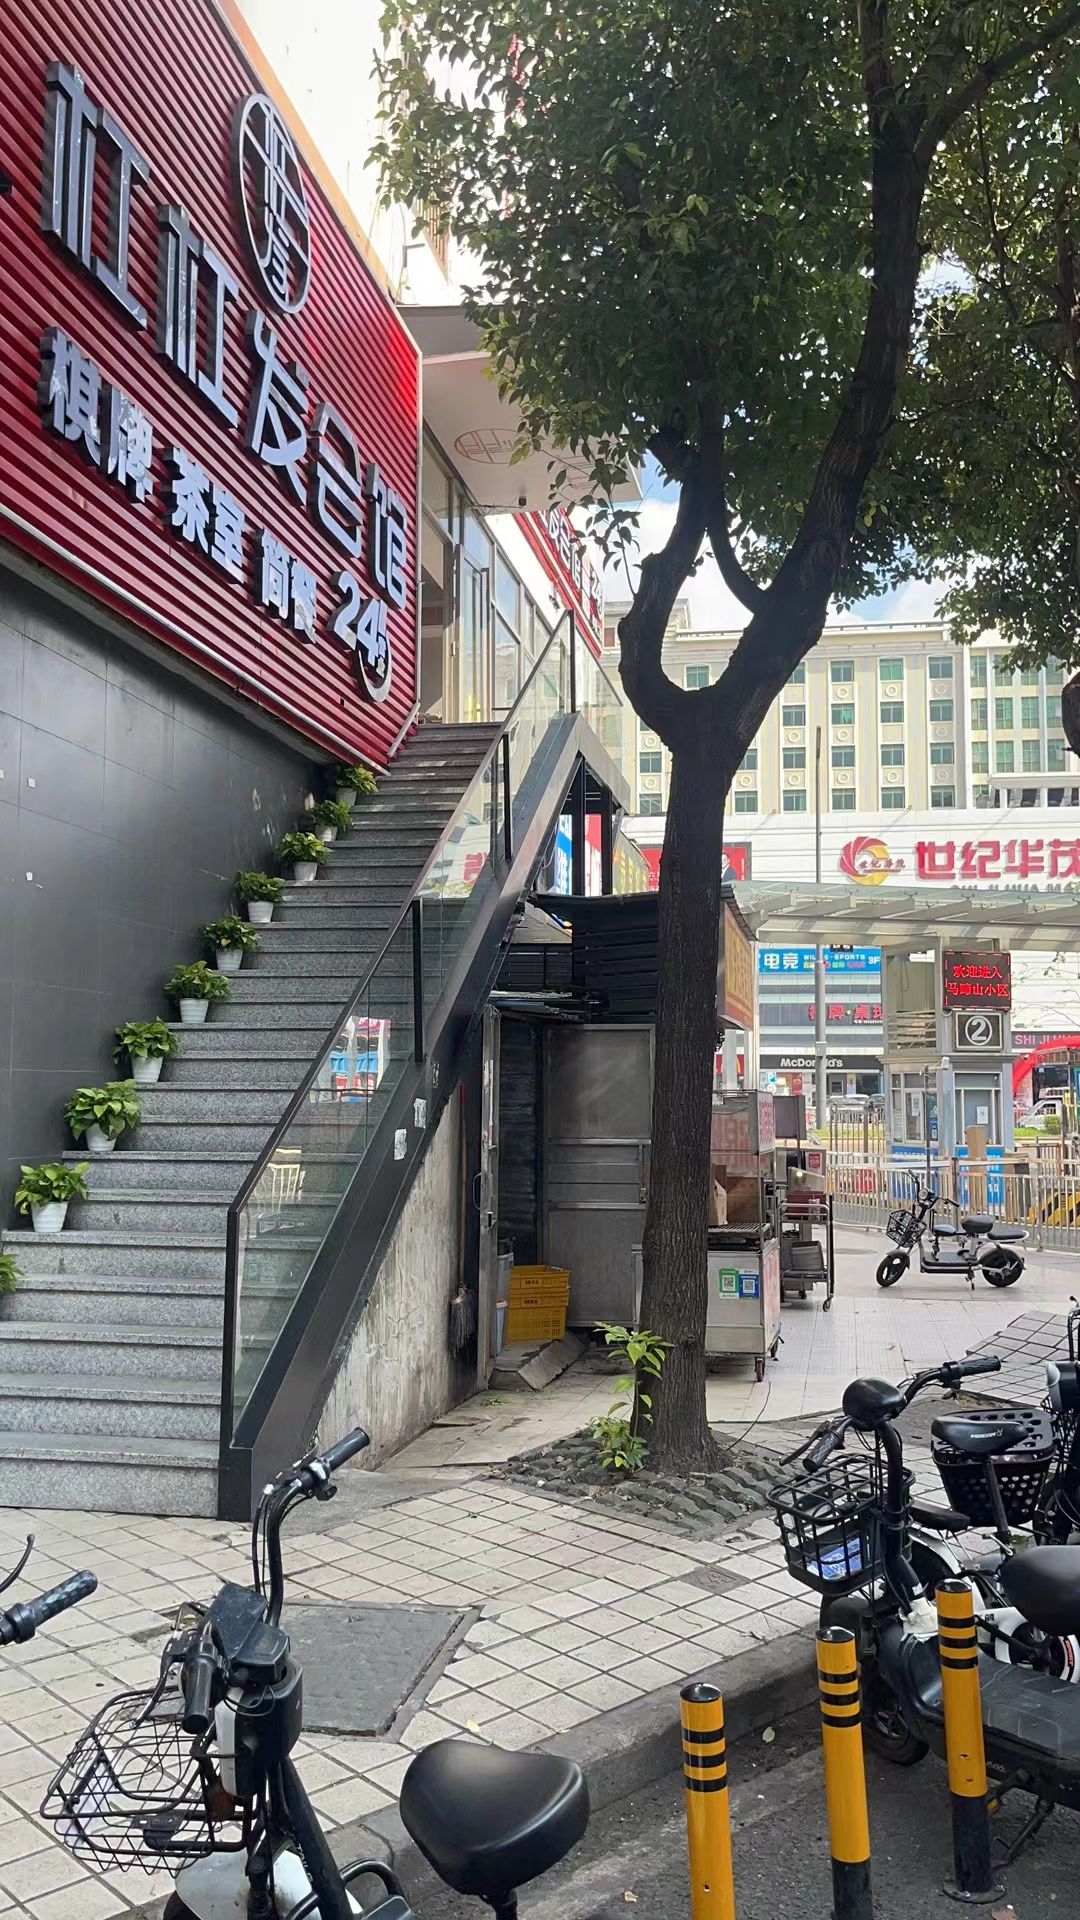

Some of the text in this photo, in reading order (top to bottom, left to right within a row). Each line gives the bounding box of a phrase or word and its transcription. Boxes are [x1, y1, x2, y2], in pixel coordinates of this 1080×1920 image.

[42, 327, 154, 502] 棋牌
[168, 446, 245, 584] 茶室
[259, 527, 318, 644] 简餐
[953, 965, 1002, 979] 欢迎进入
[1014, 1034, 1036, 1045] SHI
